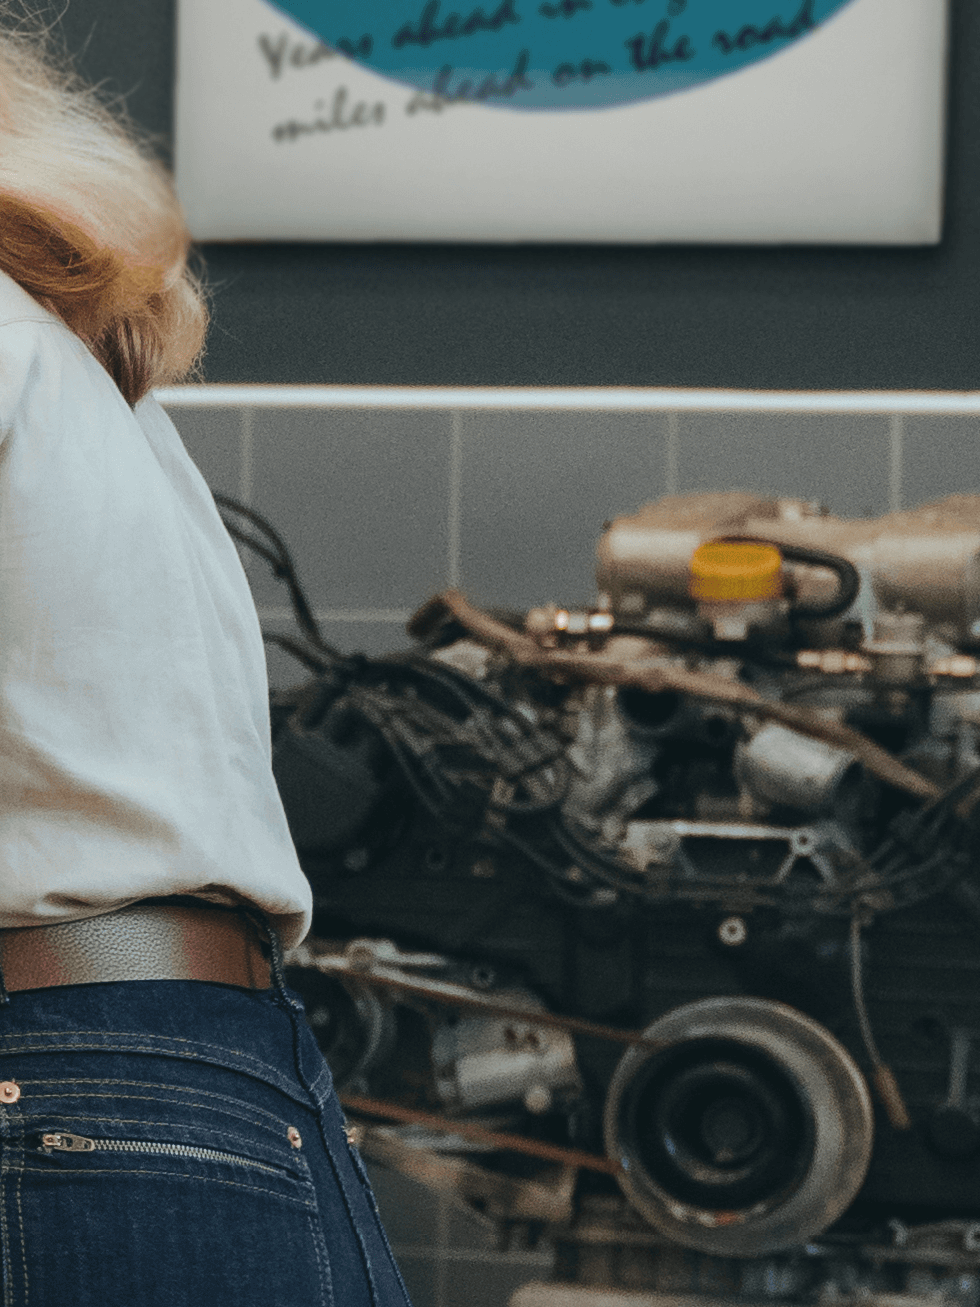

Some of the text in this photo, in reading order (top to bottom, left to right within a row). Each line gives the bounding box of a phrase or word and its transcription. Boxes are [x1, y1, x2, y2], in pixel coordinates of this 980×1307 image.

[257, 32, 374, 81] Years
[272, 83, 386, 142] miles
[404, 48, 535, 117] ahead
[552, 61, 613, 89] on
[624, 18, 696, 72] the
